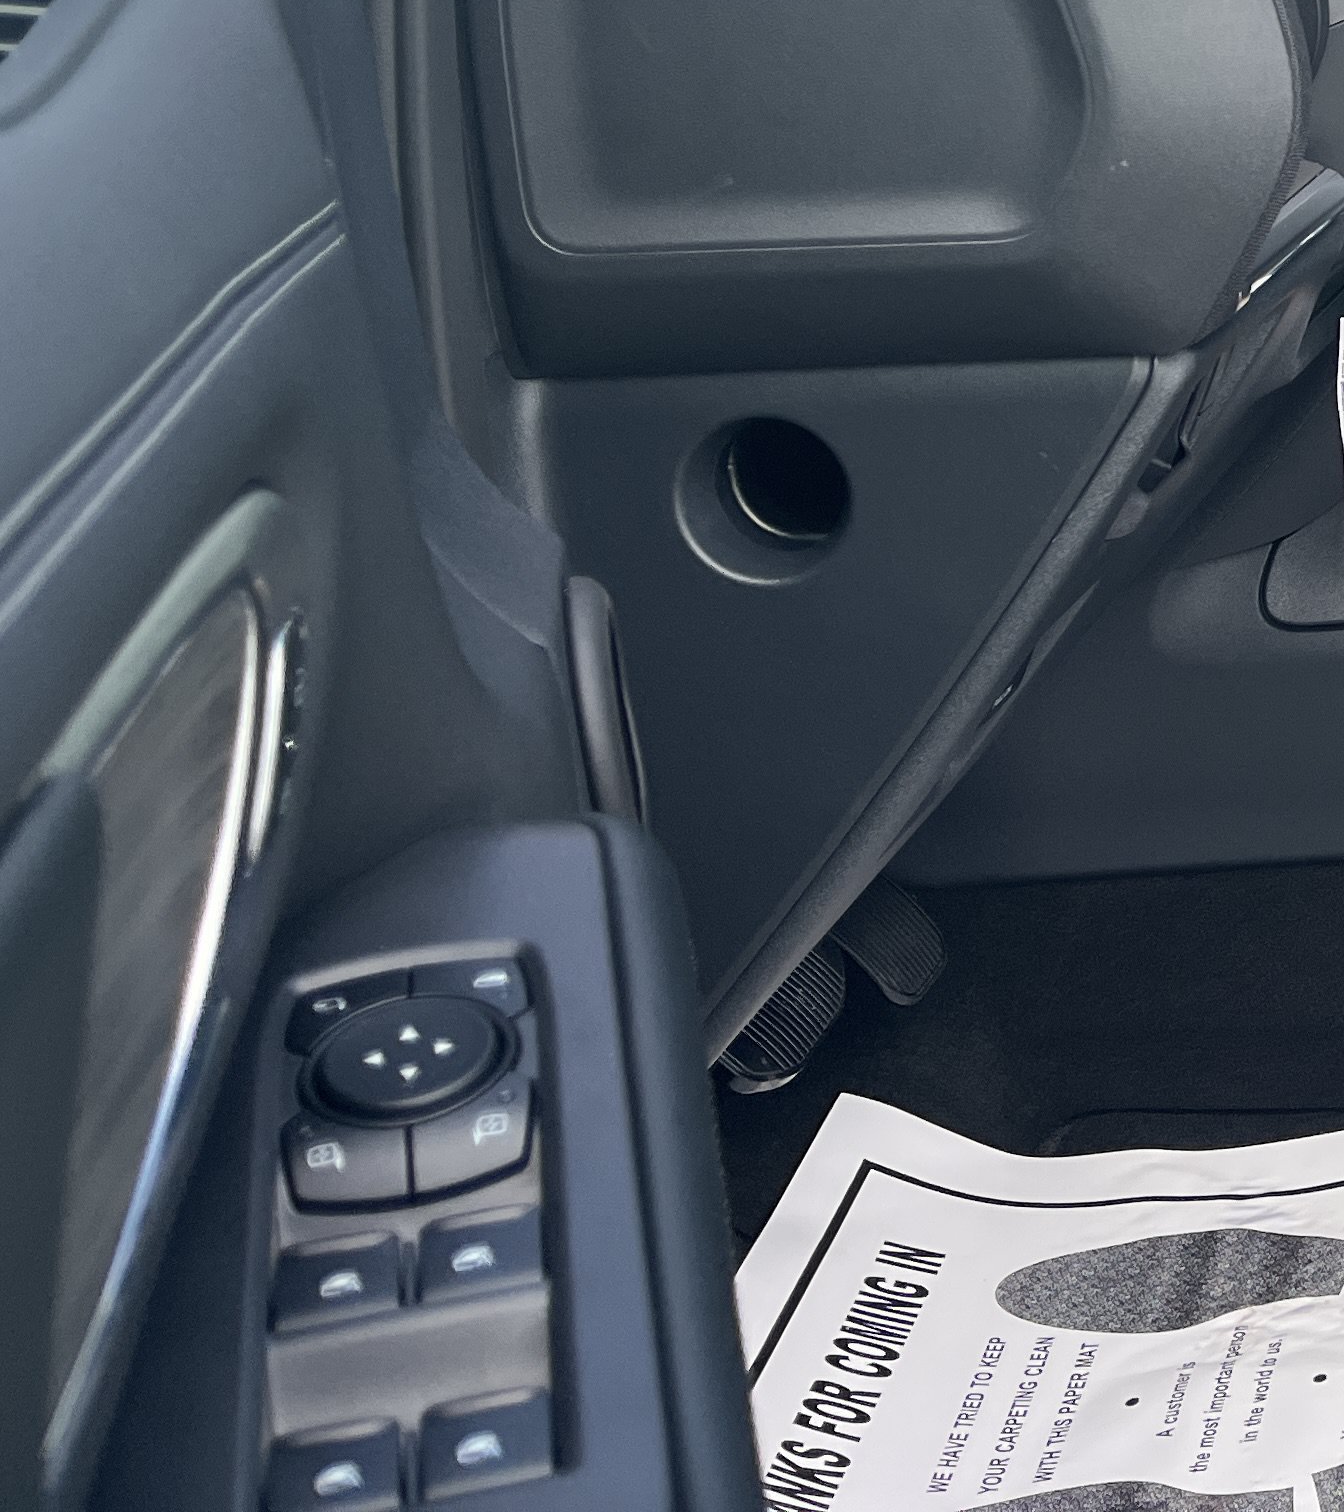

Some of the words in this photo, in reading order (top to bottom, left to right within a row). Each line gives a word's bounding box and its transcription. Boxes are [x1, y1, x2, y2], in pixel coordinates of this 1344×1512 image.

[875, 1240, 946, 1275] IN
[825, 1276, 929, 1378] COMING
[1225, 1325, 1248, 1359] person
[980, 1336, 1006, 1370] KEEP
[1074, 1342, 1100, 1368] MAT
[1260, 1357, 1277, 1367] to
[1266, 1339, 1282, 1354] us.
[970, 1371, 993, 1391] TO
[1178, 1361, 1196, 1371] is
[1057, 1371, 1090, 1414] PAPER
[1163, 1372, 1191, 1424] customer
[1204, 1360, 1237, 1414] important
[1253, 1369, 1274, 1404] world
[792, 1380, 882, 1442] FOR
[953, 1392, 985, 1431] TRIED
[978, 1457, 1011, 1496] YOUR
[995, 1381, 1038, 1455] CARPETING
[1023, 1336, 1055, 1380] CLEAN
[1244, 1407, 1264, 1427] the
[1046, 1418, 1073, 1447] THIS
[1155, 1427, 1174, 1438] A
[1199, 1416, 1221, 1448] most
[1239, 1430, 1260, 1443] in
[937, 1432, 970, 1469] HAVE
[1032, 1450, 1062, 1483] WITH
[1189, 1452, 1211, 1473] the
[927, 1471, 954, 1495] WE
